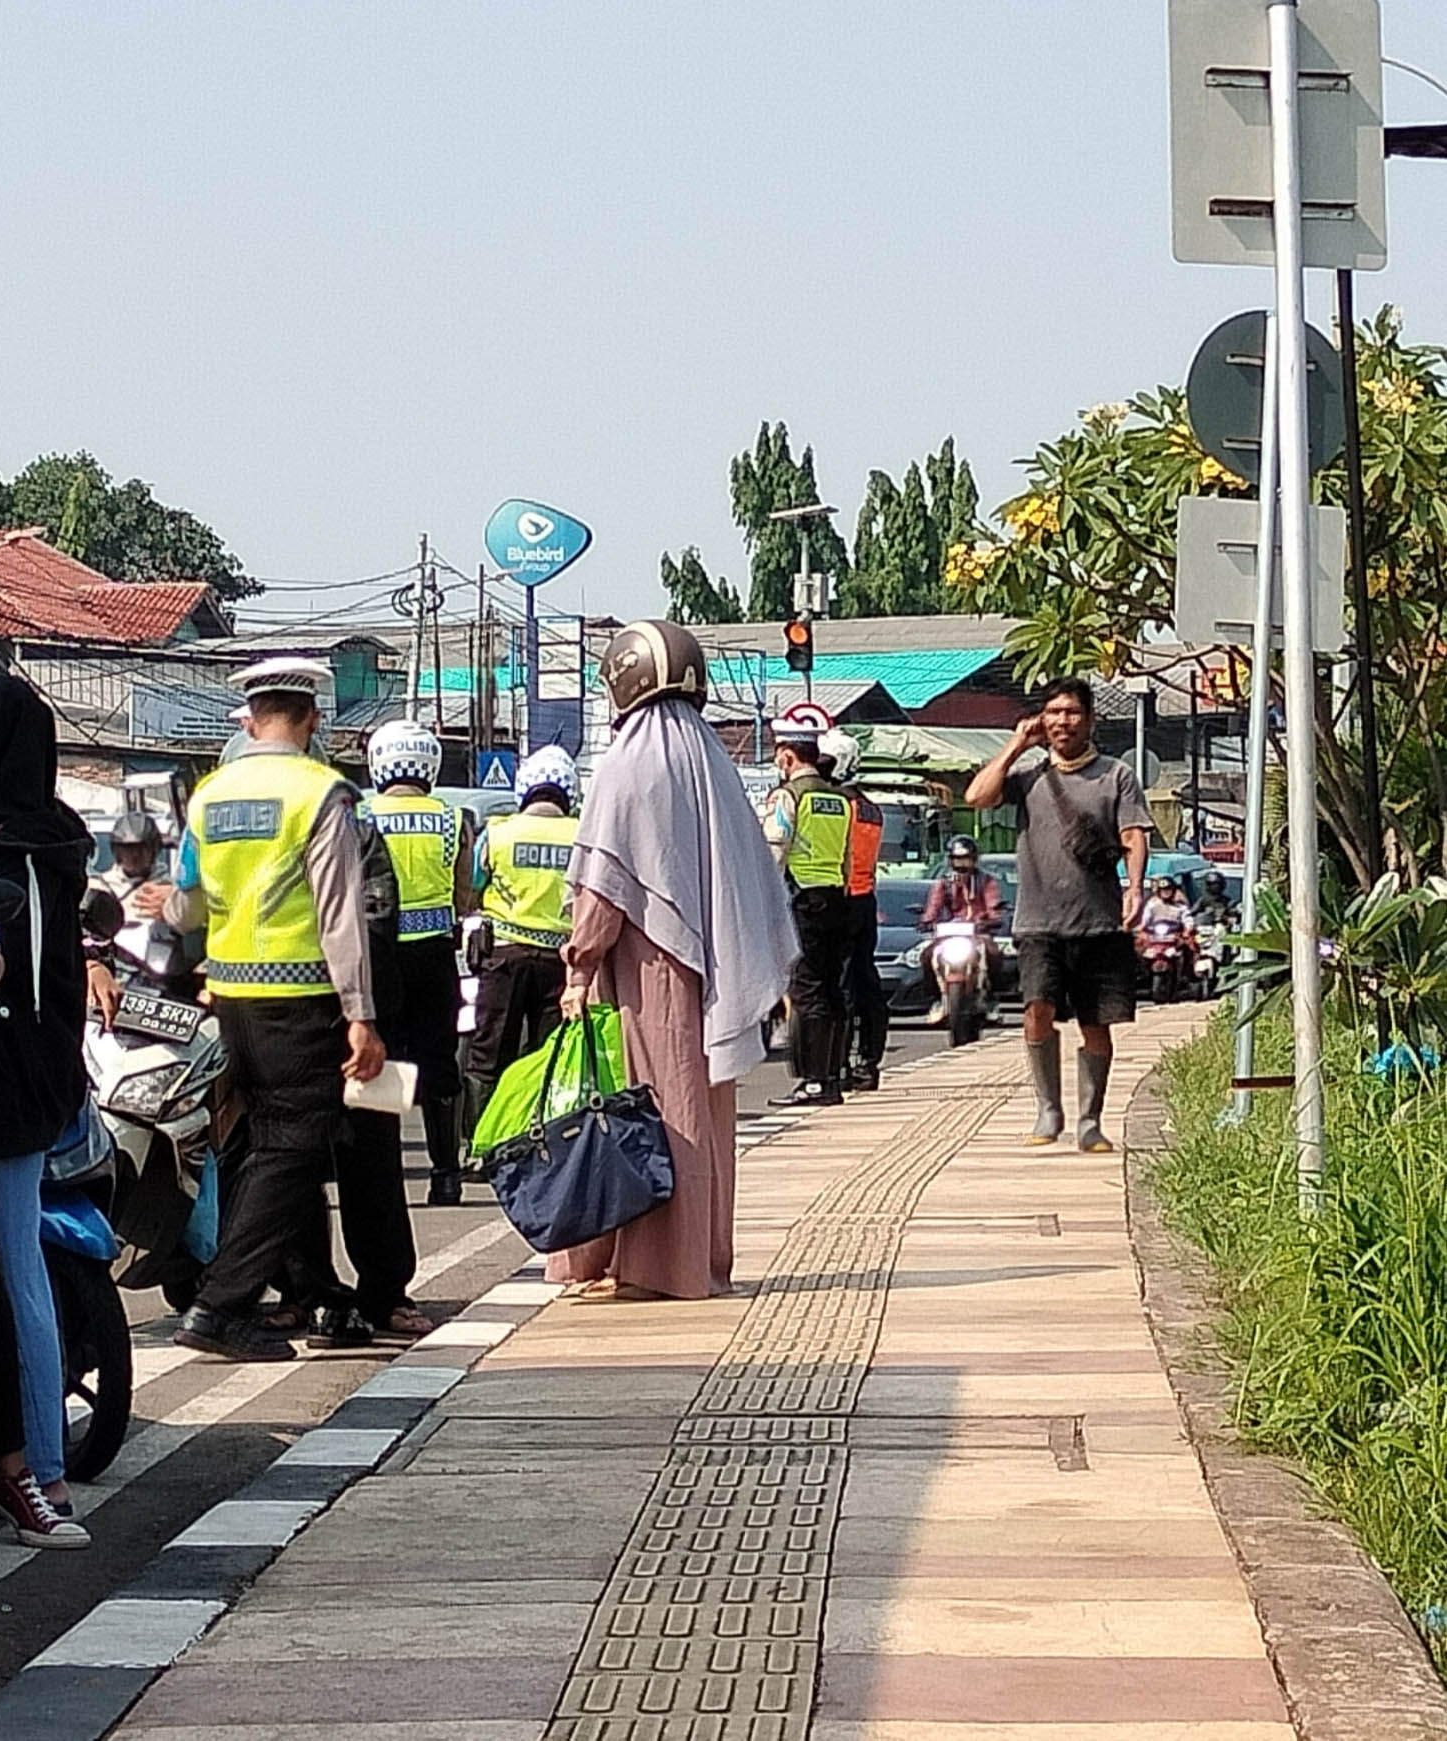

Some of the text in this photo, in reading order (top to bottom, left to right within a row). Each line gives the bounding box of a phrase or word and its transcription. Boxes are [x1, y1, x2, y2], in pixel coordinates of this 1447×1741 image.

[506, 545, 565, 562] Bluebird
[386, 740, 431, 753] POLISI
[376, 814, 443, 833] POLISI
[516, 844, 570, 864] POLIS
[159, 1004, 196, 1026] SKM
